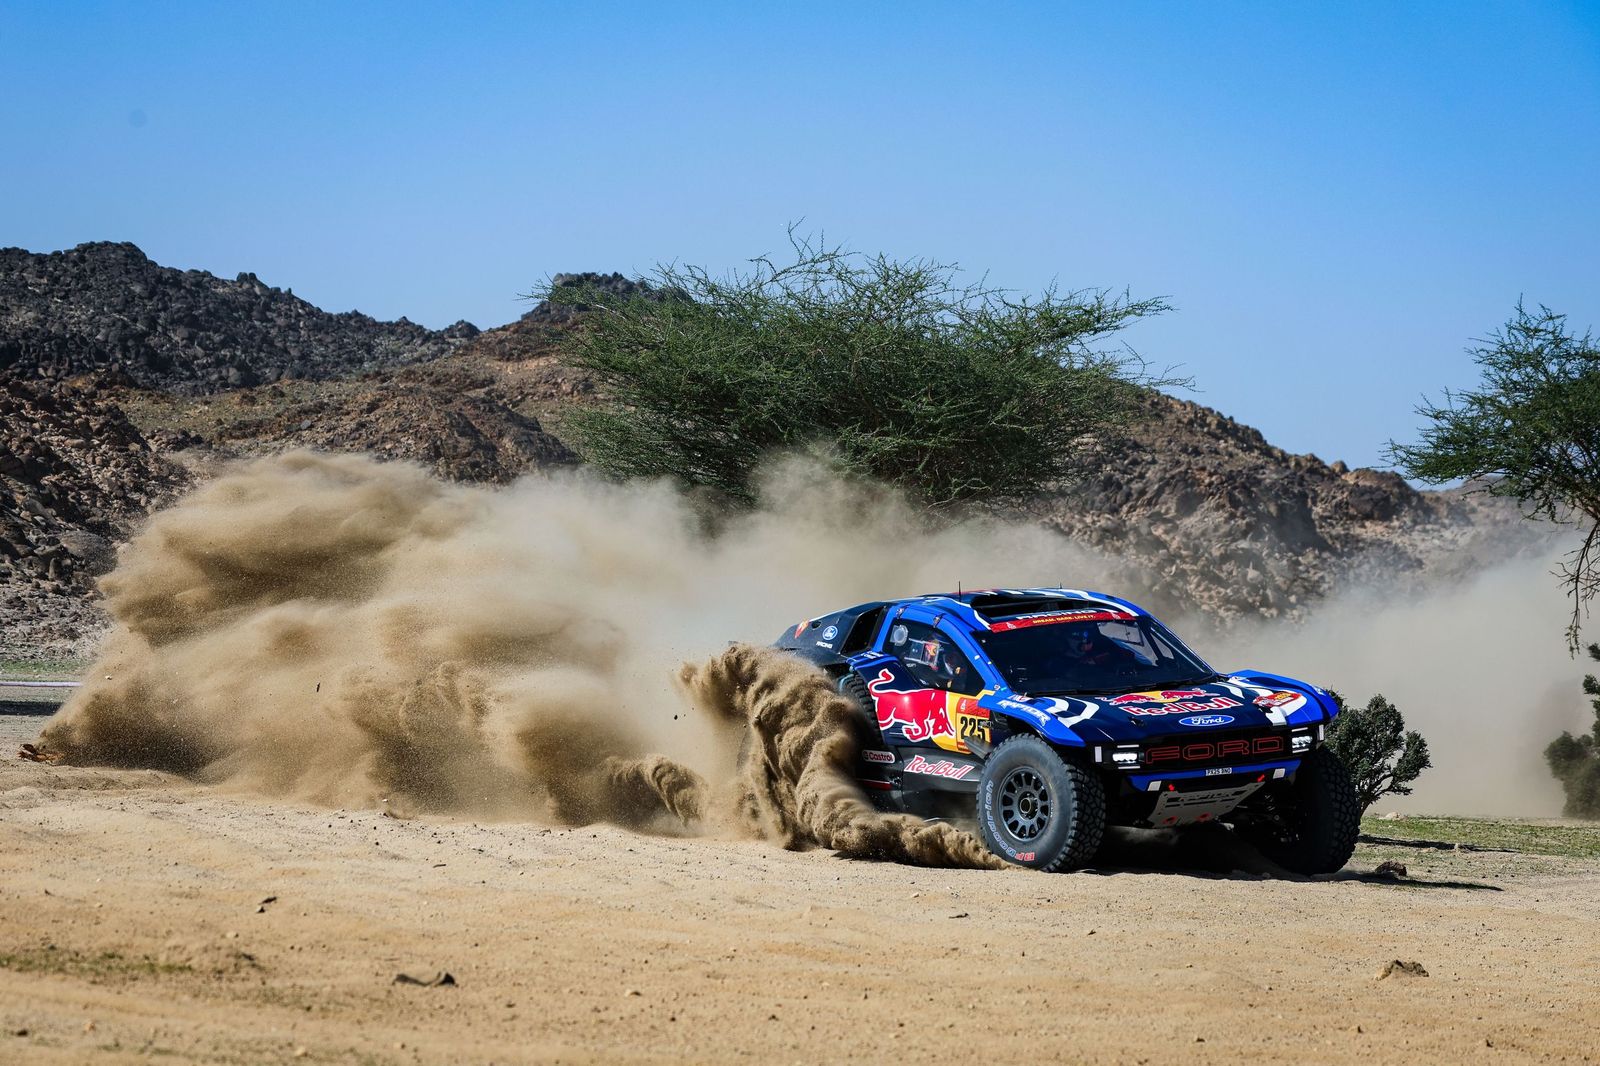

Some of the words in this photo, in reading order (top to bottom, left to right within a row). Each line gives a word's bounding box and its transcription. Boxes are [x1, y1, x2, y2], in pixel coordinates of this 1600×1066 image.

[996, 700, 1051, 726] RAPTOR
[1191, 715, 1225, 725] Ford
[960, 716, 990, 741] 225
[869, 752, 893, 761] Castrol
[1146, 736, 1283, 764] FORD
